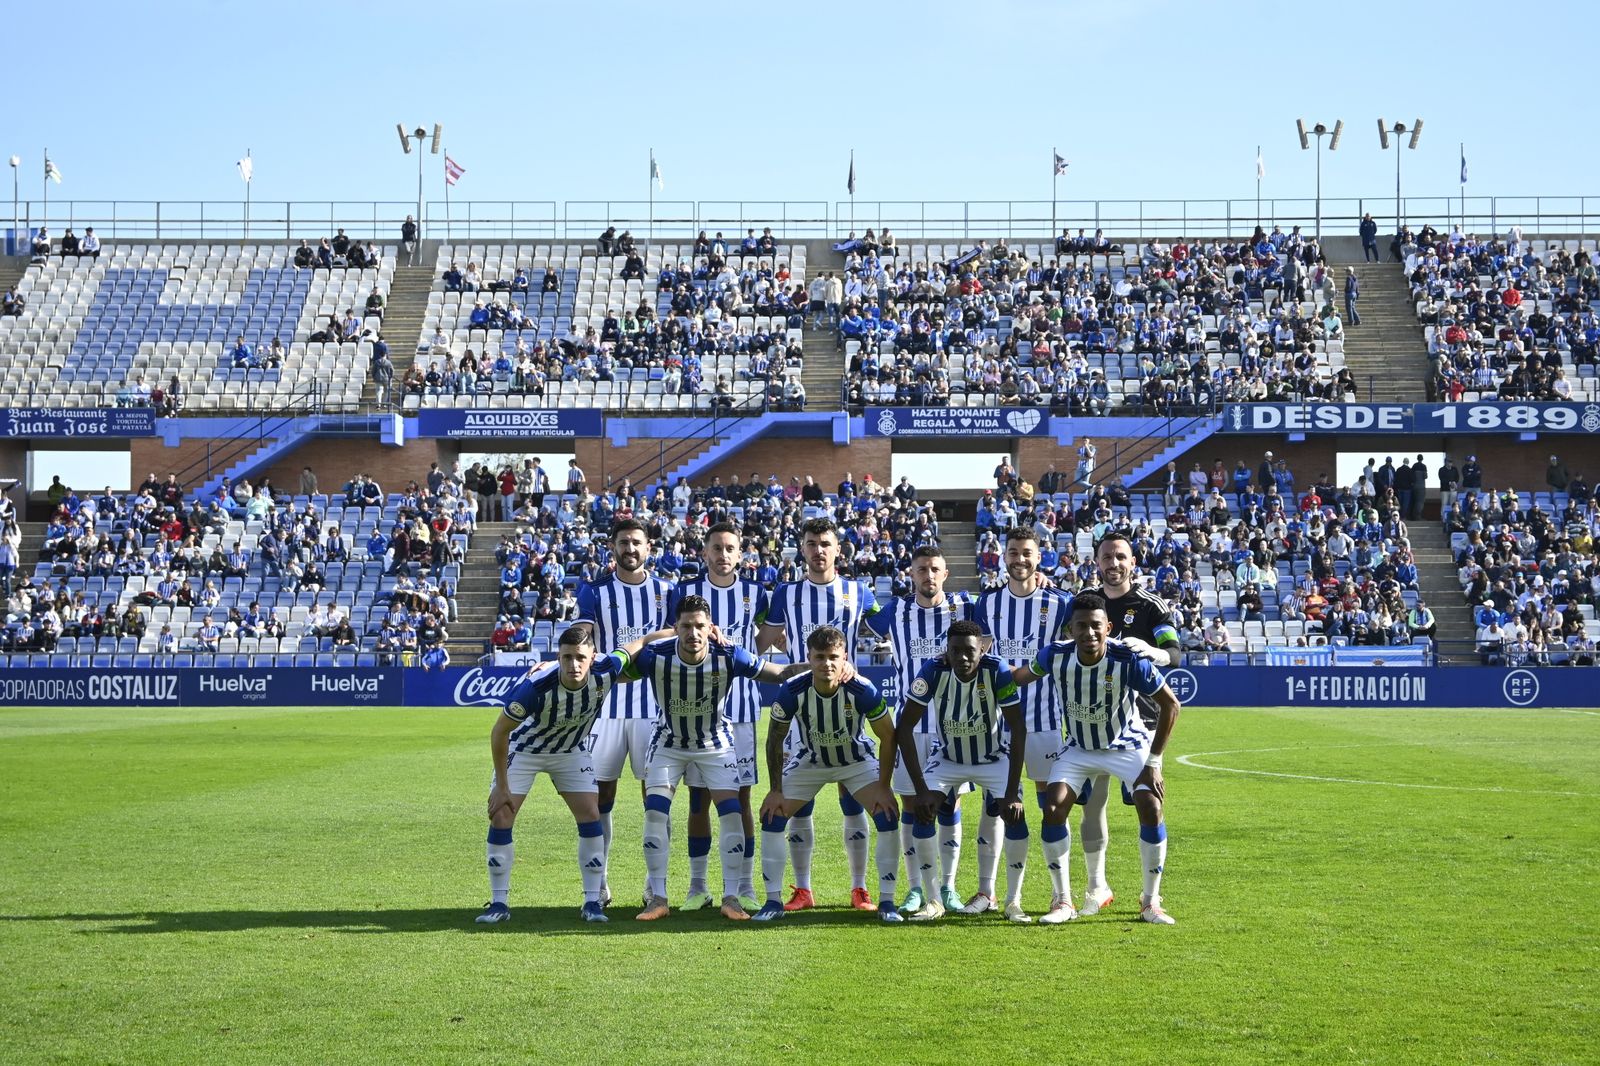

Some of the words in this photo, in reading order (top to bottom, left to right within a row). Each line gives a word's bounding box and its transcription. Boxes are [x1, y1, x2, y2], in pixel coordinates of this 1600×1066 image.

[8, 408, 31, 418] Bar
[40, 407, 108, 418] Restaurante
[465, 411, 558, 427] ALQUIBOXES
[911, 408, 947, 417] HAZTE
[949, 408, 1001, 417] DONANTE
[1252, 405, 1403, 429] DESDE
[1431, 405, 1578, 429] 1889
[7, 419, 56, 436] Juan
[62, 418, 108, 436] José
[913, 419, 956, 428] REGALA
[974, 419, 999, 428] VIDA
[531, 428, 575, 436] PARTÍCULAS
[617, 626, 641, 635] alter
[911, 638, 933, 647] alter
[999, 639, 1021, 648] alter
[88, 675, 177, 700] COSTALUZ
[200, 674, 266, 692] Huelva
[312, 674, 378, 692] Huelva
[1310, 673, 1426, 701] FEDERACIÓN
